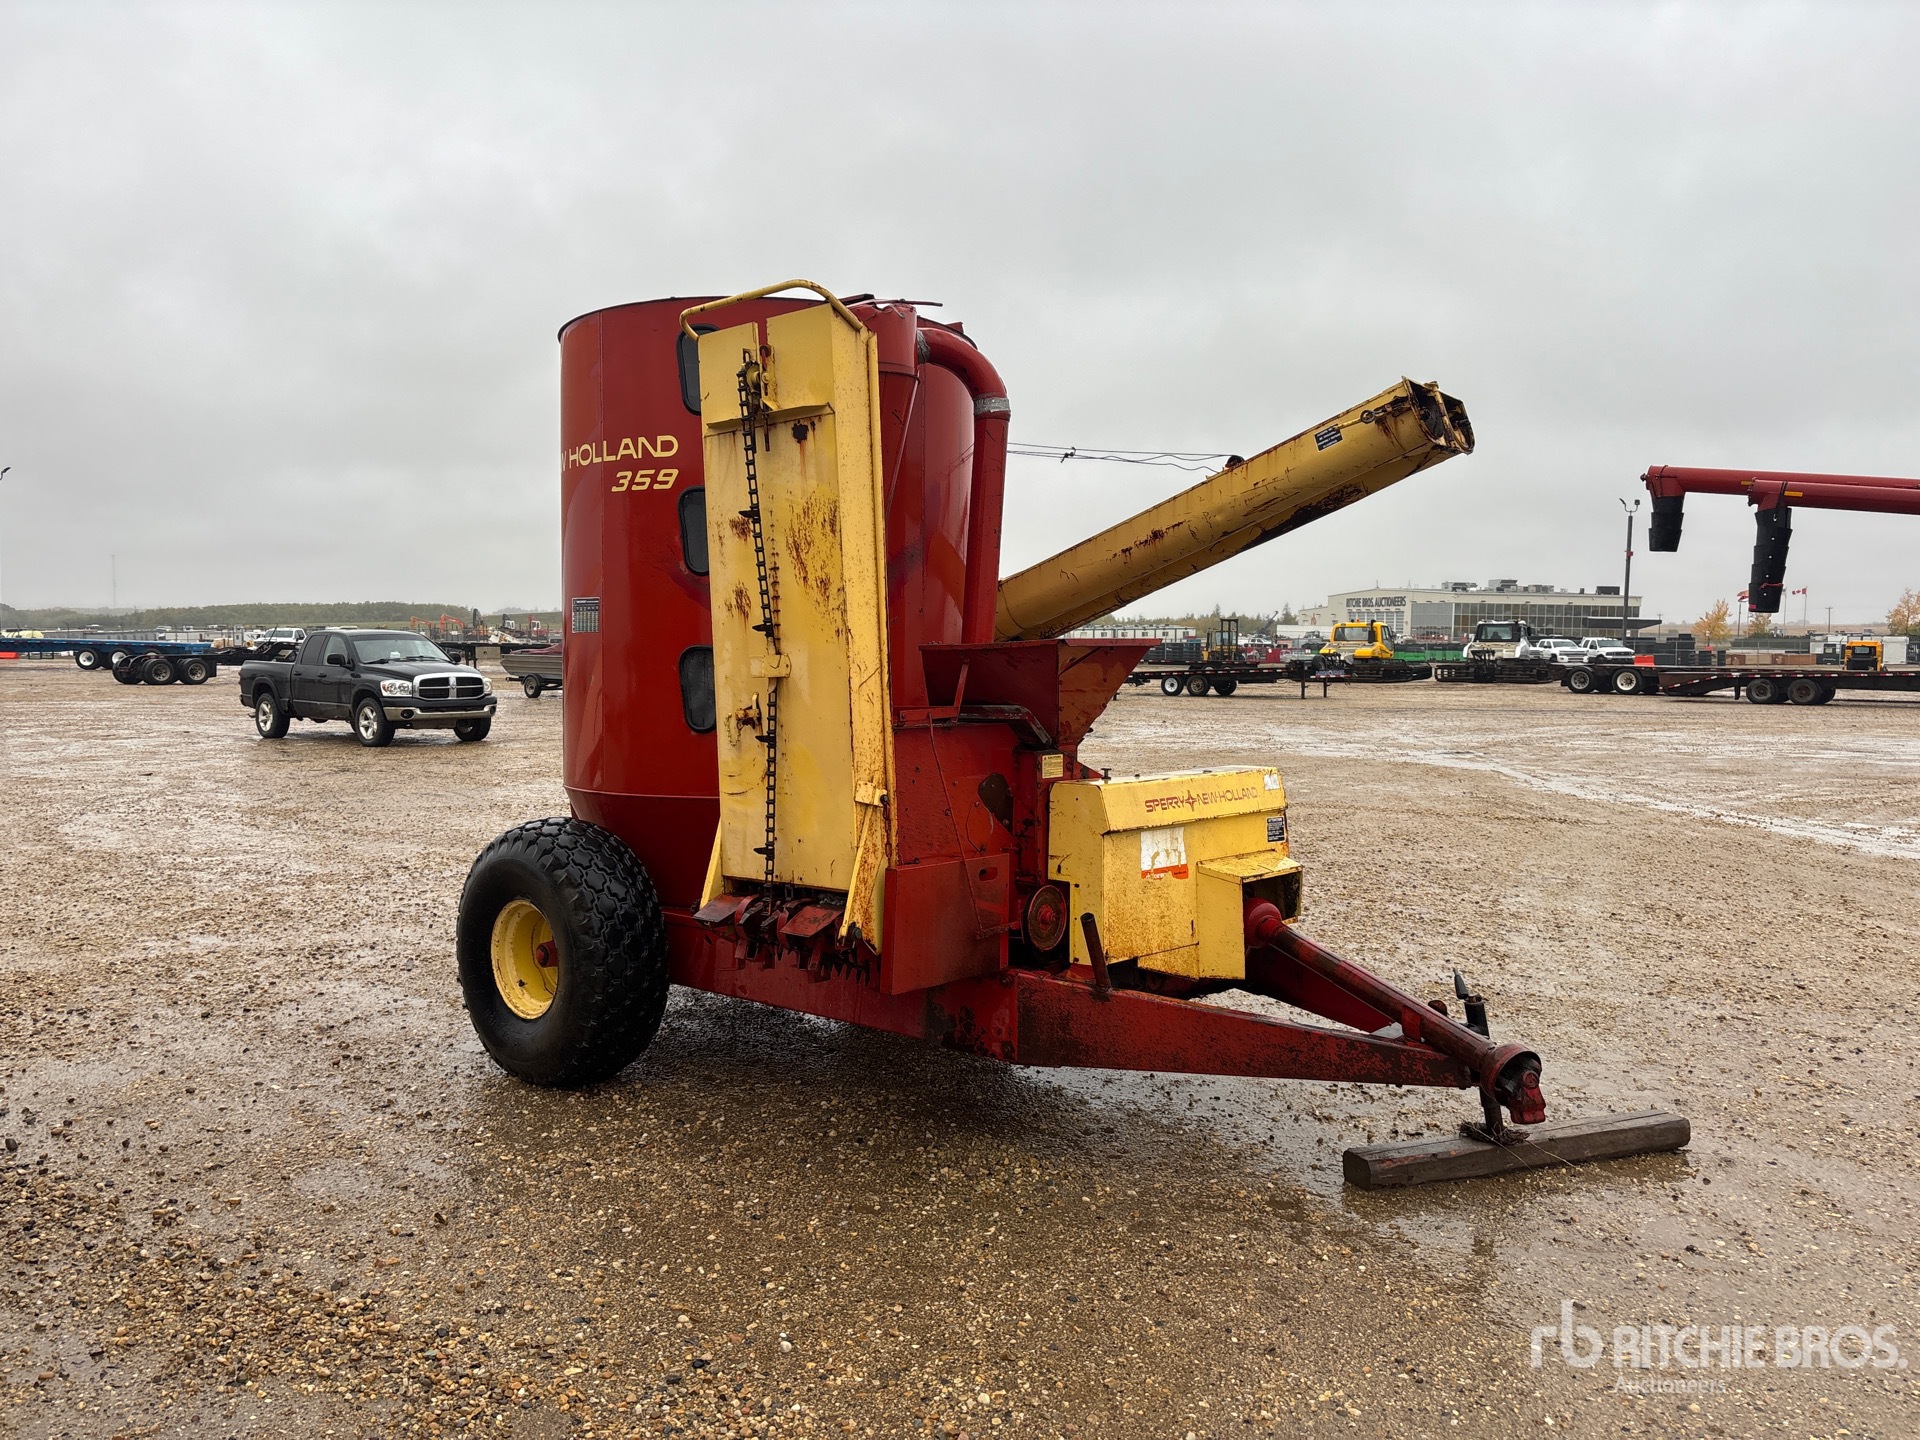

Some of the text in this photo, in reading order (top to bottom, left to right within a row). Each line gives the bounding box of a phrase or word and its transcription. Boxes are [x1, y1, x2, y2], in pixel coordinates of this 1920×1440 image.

[569, 435, 679, 470] HOLLAND
[611, 468, 679, 492] 359
[1375, 596, 1406, 607] AUCTIONEERS
[1144, 795, 1185, 813] SPERRY
